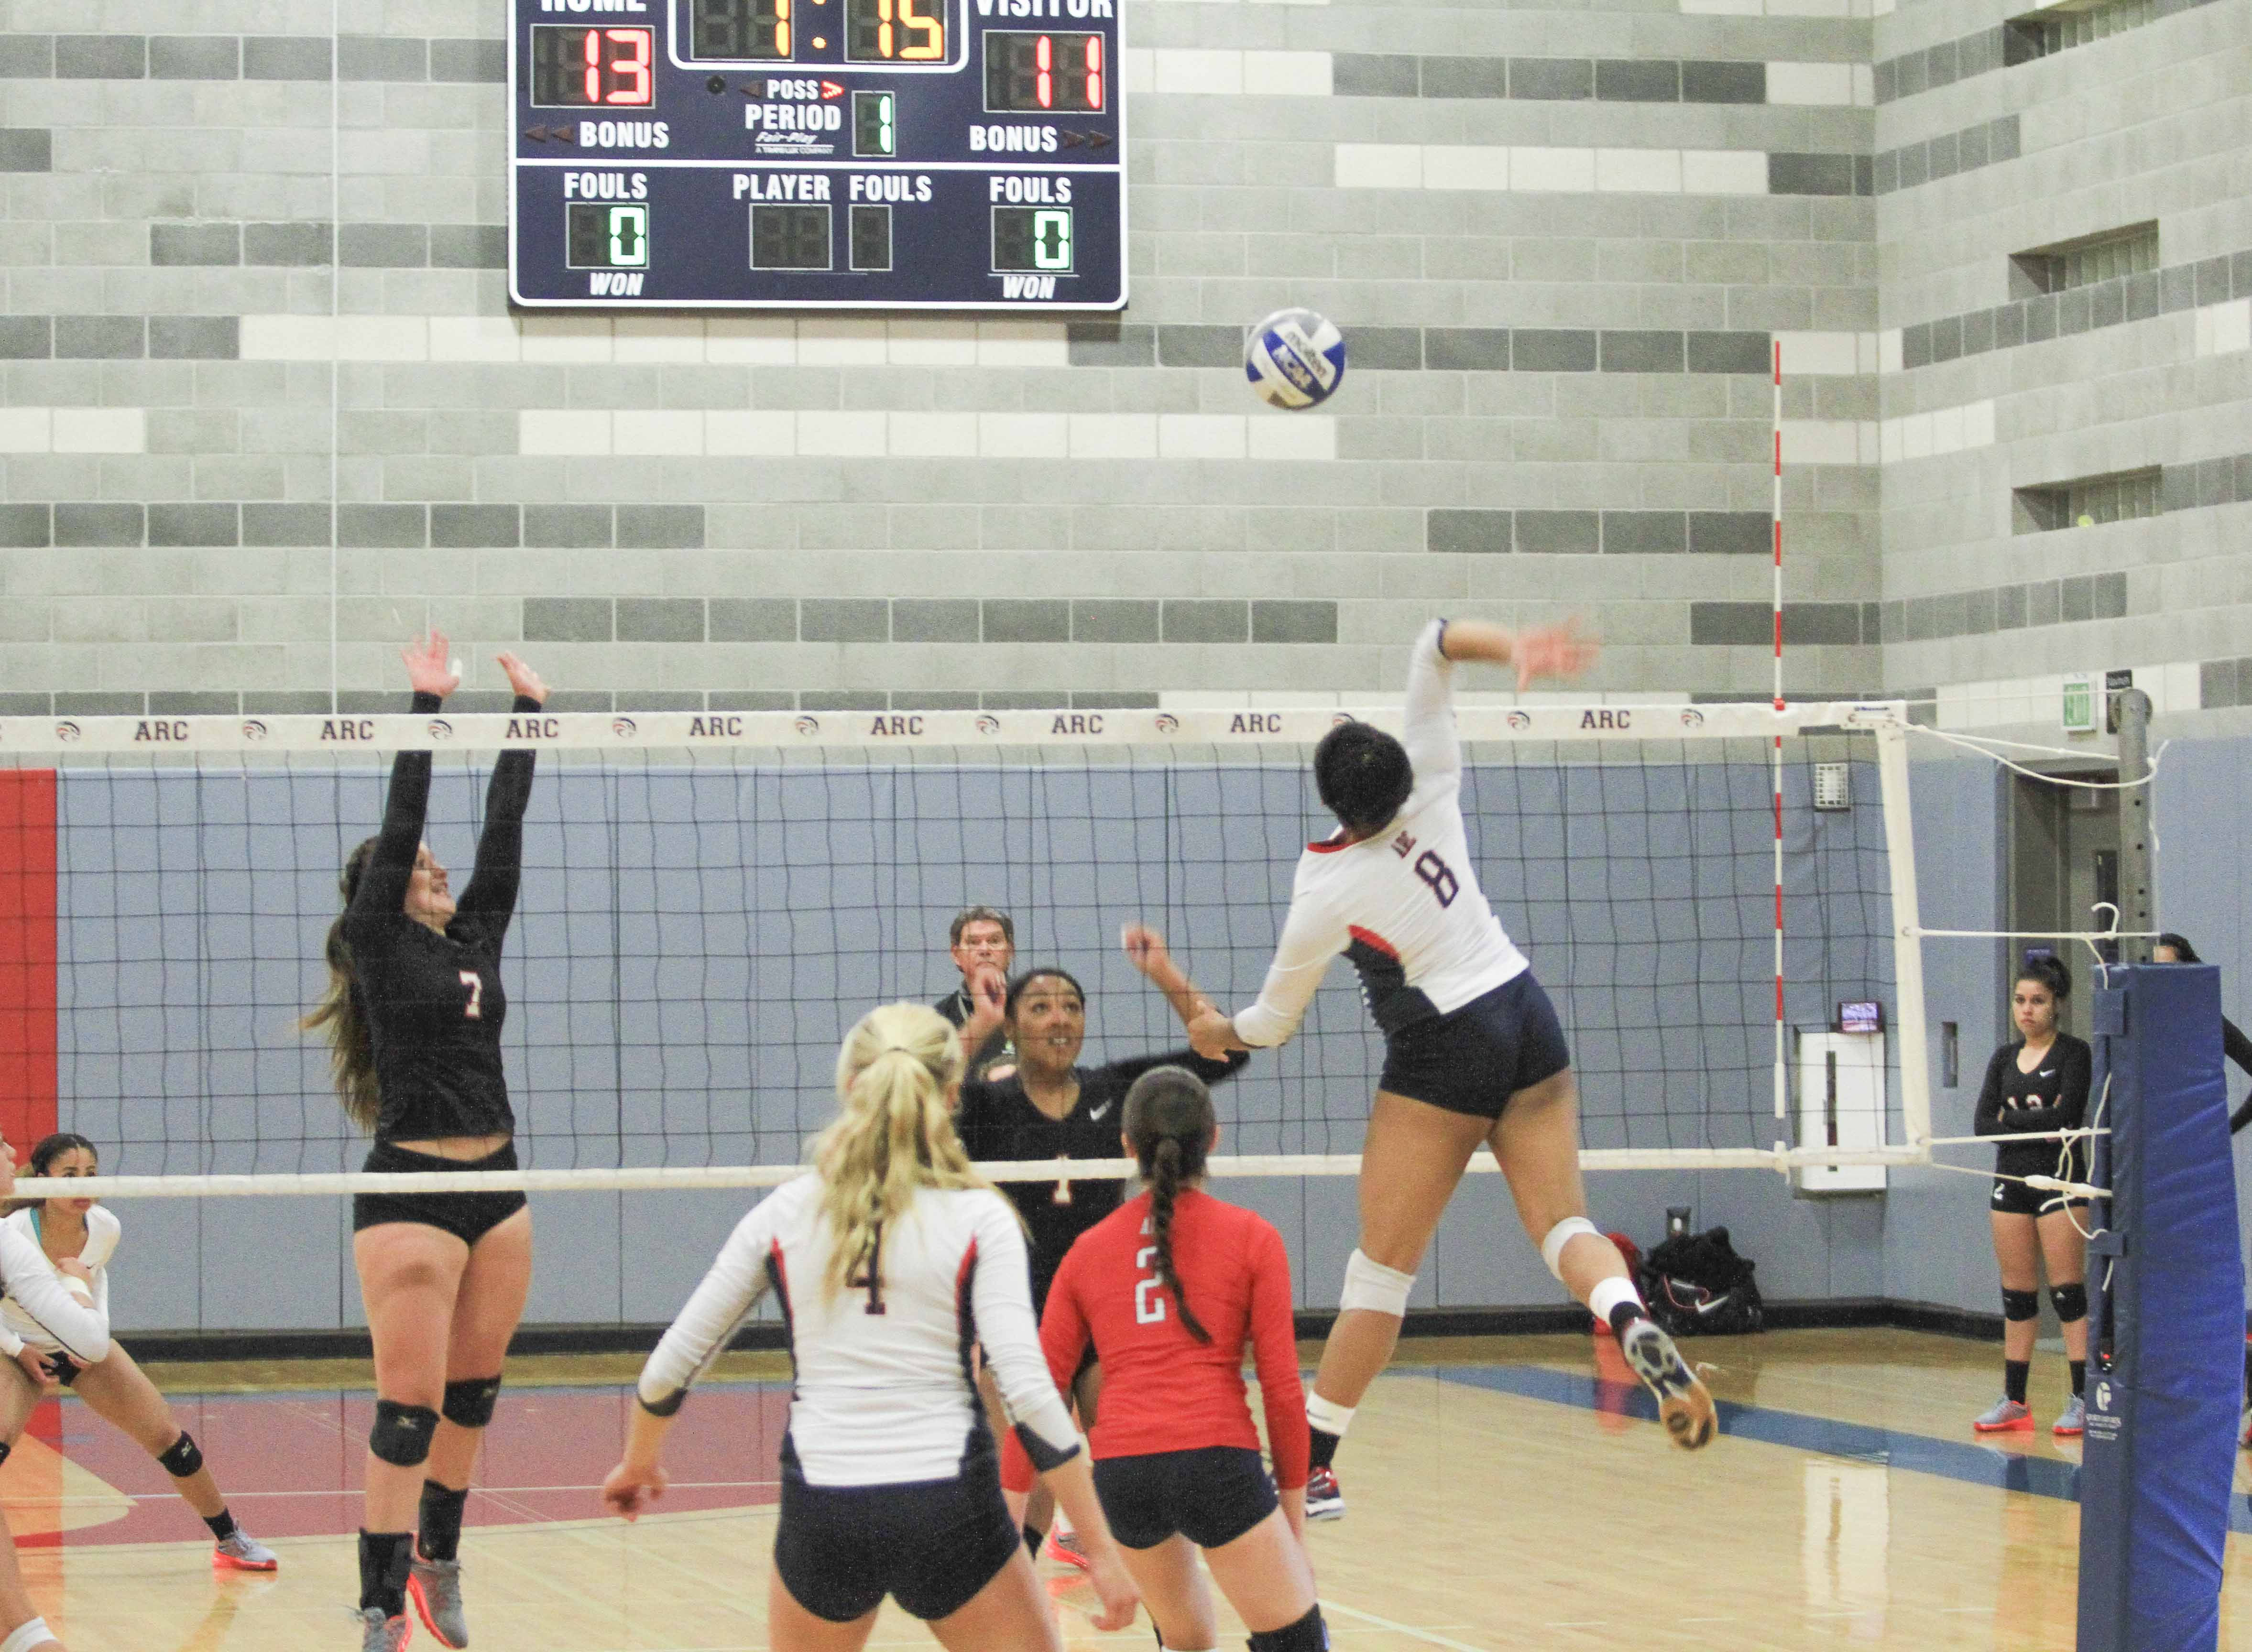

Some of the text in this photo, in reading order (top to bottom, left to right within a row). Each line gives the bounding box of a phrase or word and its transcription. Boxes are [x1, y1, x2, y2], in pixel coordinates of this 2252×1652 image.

[585, 29, 651, 104] 13
[1036, 35, 1102, 109] 11
[766, 79, 819, 99] POSS
[744, 103, 842, 130] PERIOD
[879, 95, 892, 153] 1
[579, 121, 670, 148] BONUS
[969, 125, 1058, 152] BONUS
[564, 172, 648, 199] FOULS
[732, 174, 932, 202] PLAYER FOULS
[989, 176, 1072, 203] FOULS
[610, 206, 646, 266] 0
[1034, 210, 1070, 269] 0
[589, 272, 645, 296] WON
[1003, 276, 1057, 299] WON
[134, 710, 1631, 741] ARC ARC ARC ARC ARC ARC ARC ARC
[1414, 849, 1459, 909] 8
[458, 969, 483, 1021] 7
[1135, 1246, 1166, 1325] 2
